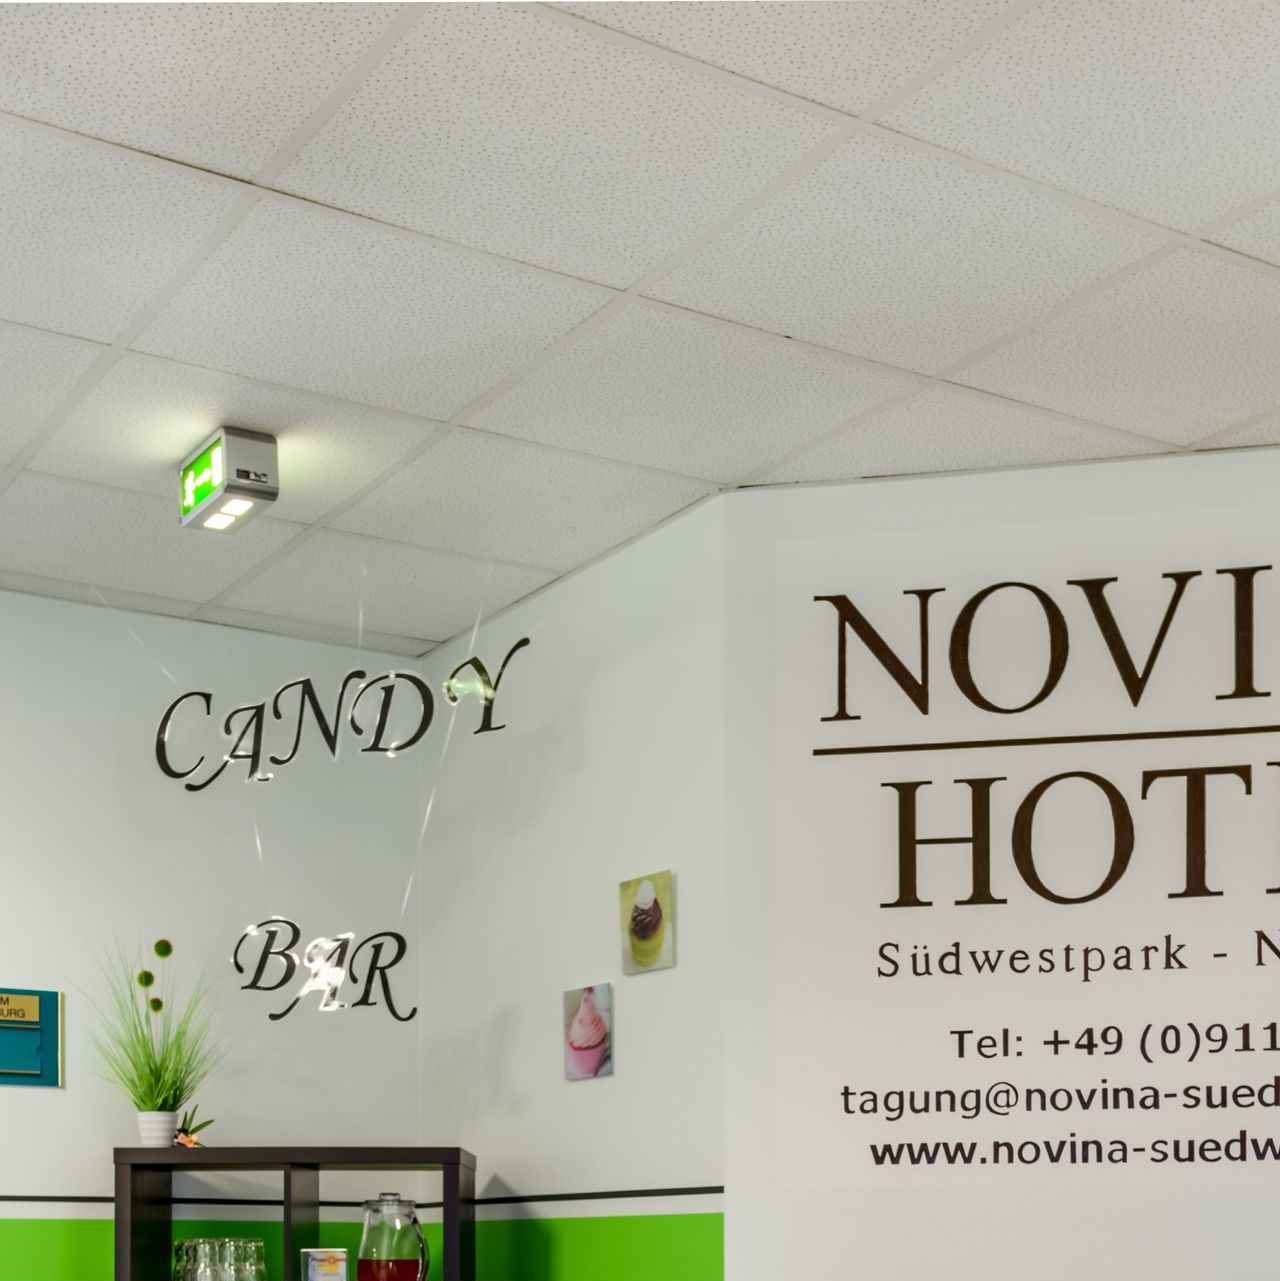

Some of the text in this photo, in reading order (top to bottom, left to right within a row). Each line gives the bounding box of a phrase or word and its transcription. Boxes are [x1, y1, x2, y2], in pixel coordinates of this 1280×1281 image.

[154, 636, 531, 793] CANDY
[231, 917, 419, 1023] BAR
[877, 934, 1189, 983] Südwestpark
[949, 1027, 1024, 1059] Tel:
[1042, 1025, 1125, 1057] +49
